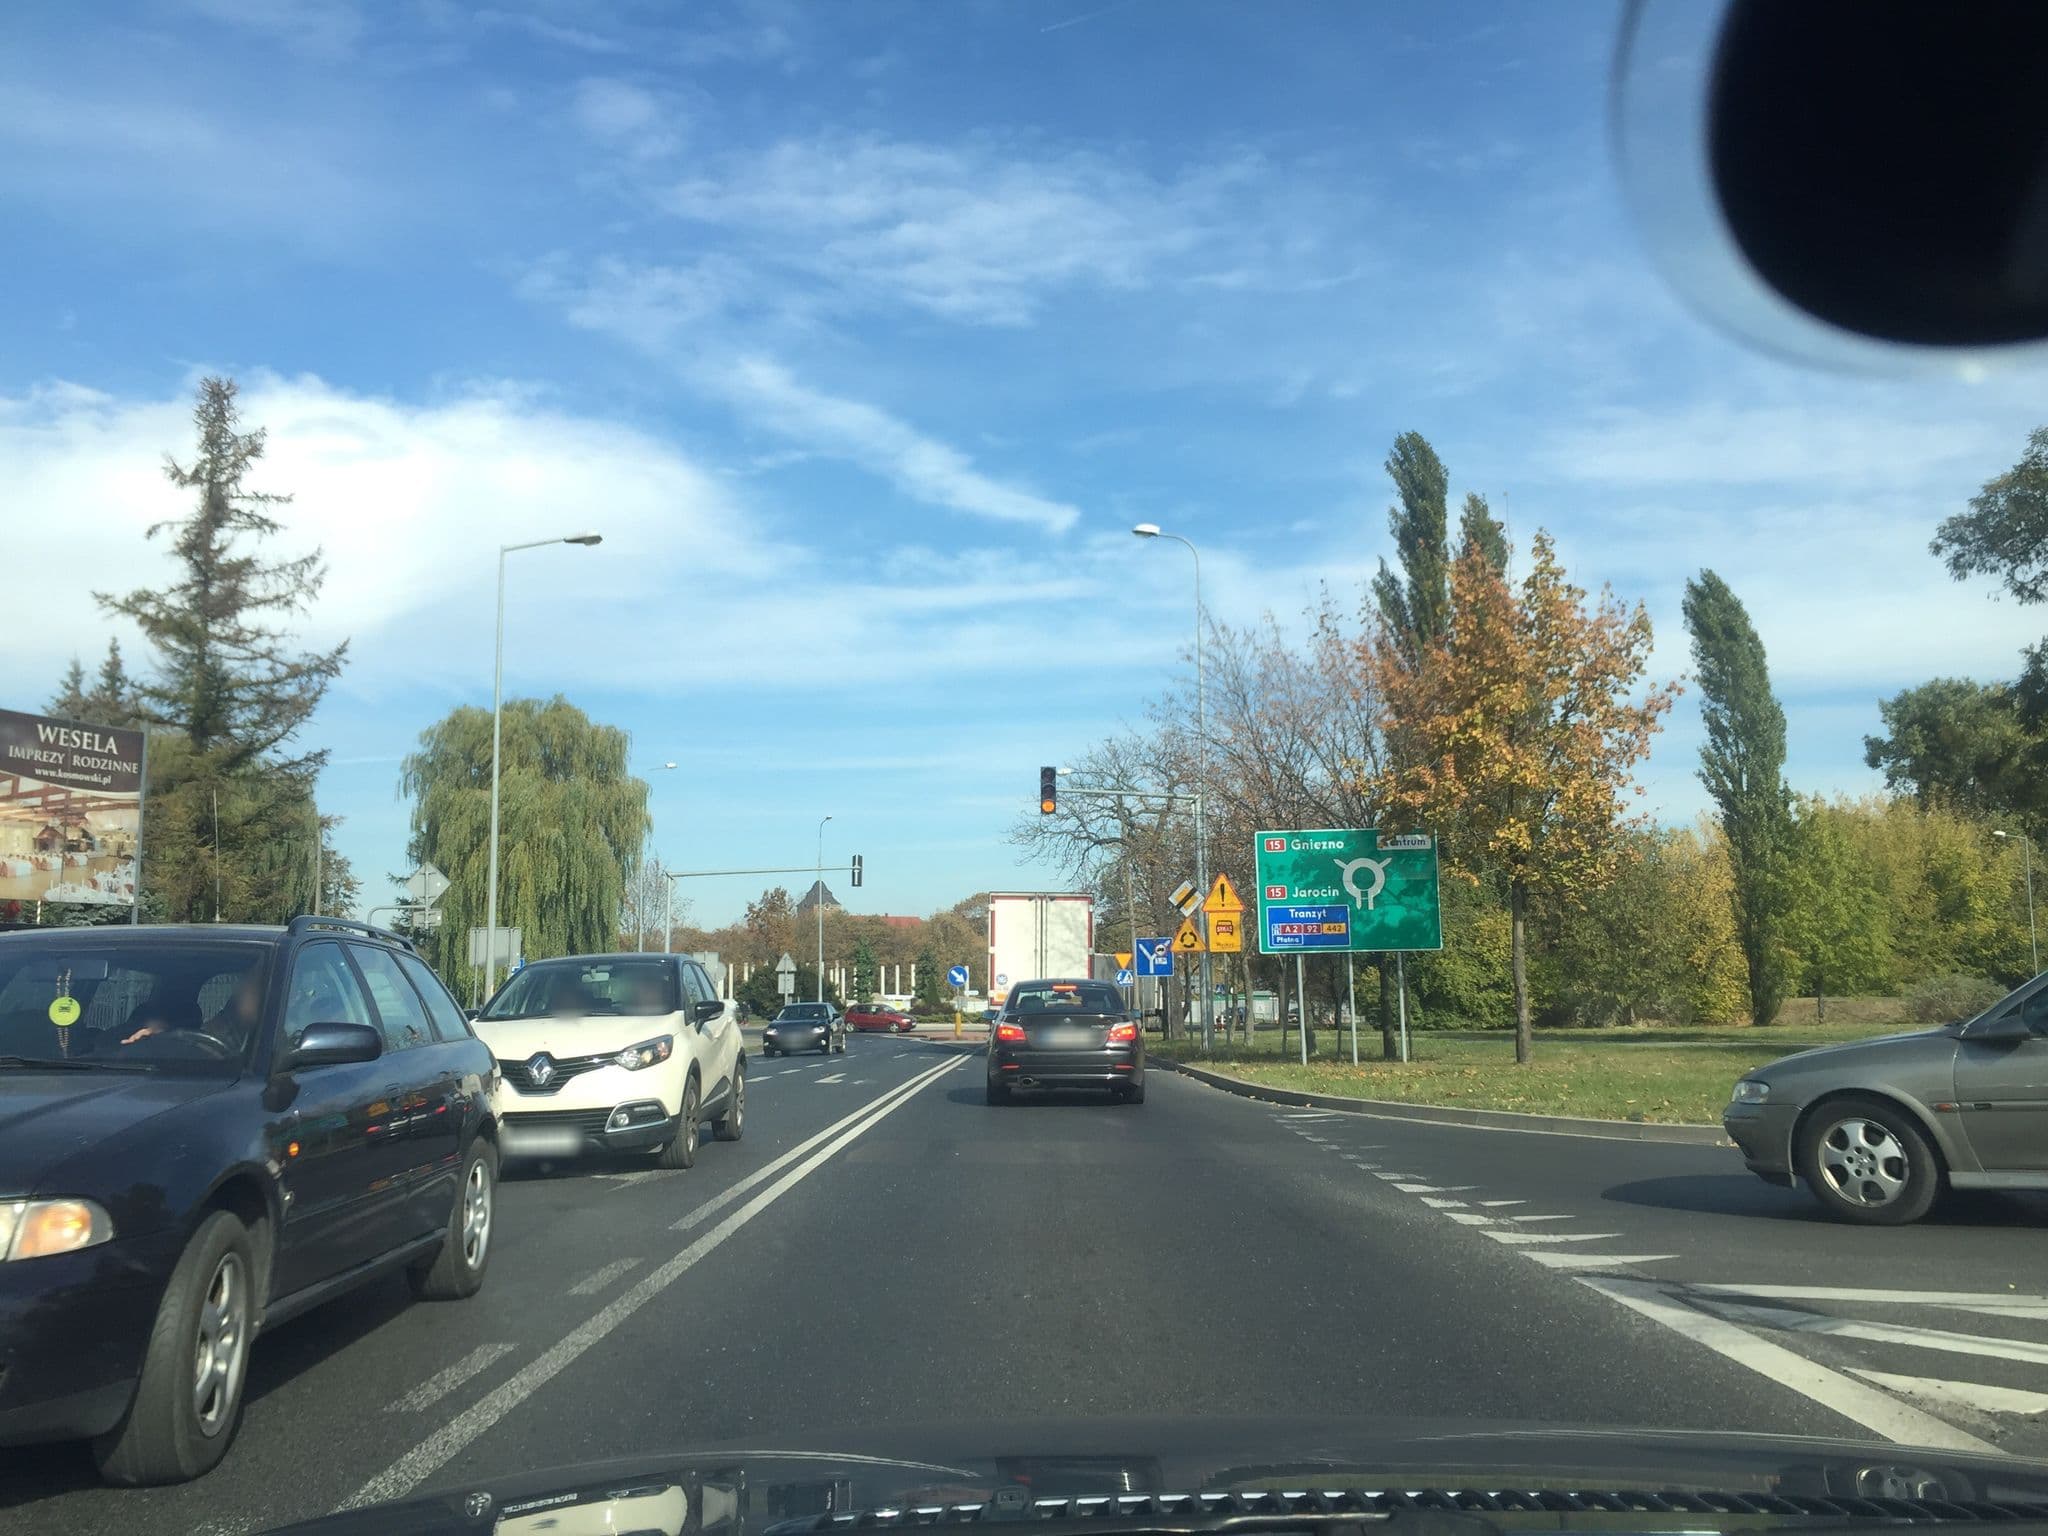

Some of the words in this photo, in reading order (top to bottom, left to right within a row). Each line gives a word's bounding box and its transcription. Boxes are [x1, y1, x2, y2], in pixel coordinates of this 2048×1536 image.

[37, 724, 119, 755] WESELA
[8, 745, 66, 765] IMPREZY
[1269, 840, 1281, 850] 15
[1290, 838, 1345, 851] Gniezno
[1270, 887, 1282, 897] 15
[1292, 886, 1339, 898] Jarocin
[1289, 908, 1327, 920] Tranzyt
[1307, 925, 1318, 933] 92
[1326, 924, 1342, 933] 442
